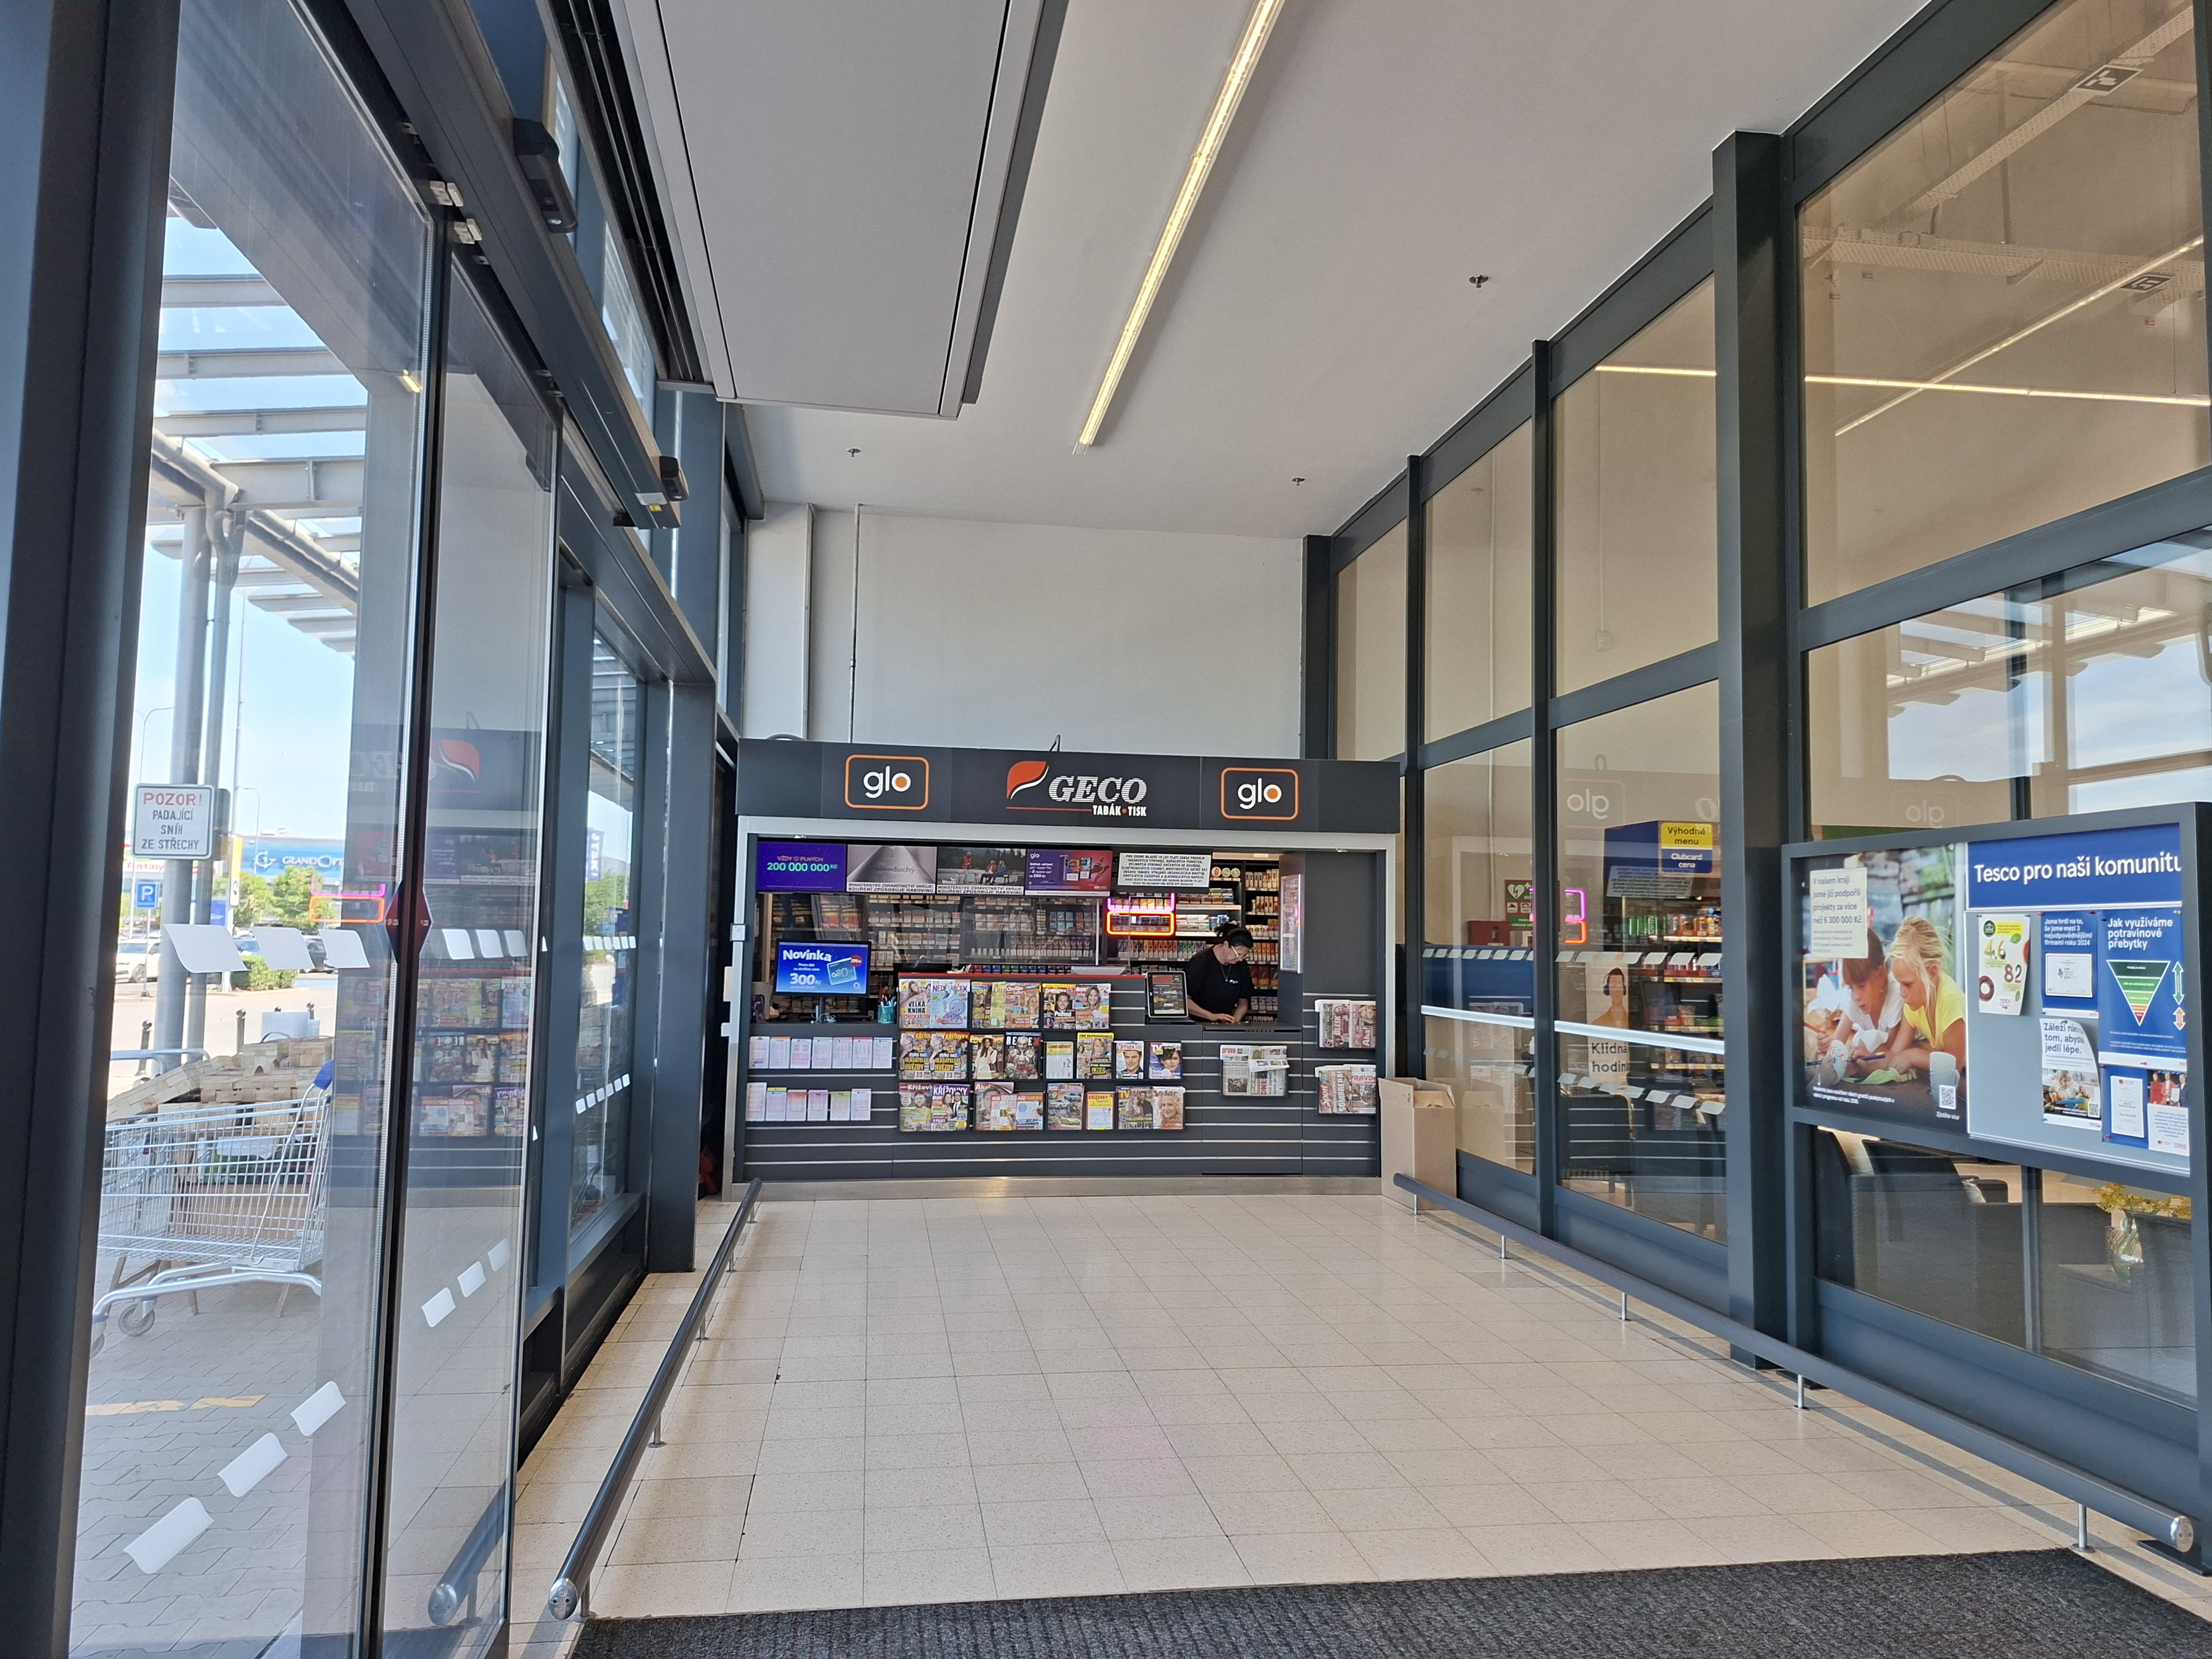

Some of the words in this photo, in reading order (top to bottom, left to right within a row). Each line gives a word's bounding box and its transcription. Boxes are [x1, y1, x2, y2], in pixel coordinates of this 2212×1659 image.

[863, 765, 911, 799] glo
[1048, 775, 1147, 804] GECO
[1238, 778, 1282, 810] glo
[143, 792, 202, 806] POZOR!
[153, 808, 194, 821] PADAJÍCÍ
[1092, 803, 1121, 816] TABÁK
[1128, 806, 1147, 817] TISK
[160, 823, 182, 835] SNÍH
[1667, 826, 1706, 836] Výhodné
[142, 839, 154, 849] ZE
[158, 837, 199, 850] STŘECHY
[767, 862, 786, 871] 200
[789, 863, 808, 872] 000
[811, 863, 830, 872] 000
[1974, 864, 2020, 883] Tesco
[2023, 865, 2053, 885] pro
[2057, 855, 2090, 878] naši
[1837, 876, 1850, 885] kraji
[142, 885, 153, 901] P
[1835, 889, 1861, 899] podpořili
[1813, 904, 1835, 912] projekty
[1854, 915, 1863, 924] Kč
[2107, 918, 2123, 927] Jak
[2125, 917, 2173, 930] využíváme
[2108, 928, 2162, 939] potravinové
[782, 950, 832, 962] Novinka
[790, 973, 816, 985] 300
[1333, 1015, 1342, 1036] BLESK
[2044, 1022, 2066, 1031] Záleží
[1362, 1027, 1371, 1047] Aha!
[2044, 1034, 2062, 1043] tom,
[2064, 1035, 2084, 1045] abyste
[1591, 1042, 1627, 1055] Klidná
[2045, 1043, 2061, 1053] jedli
[2063, 1044, 2081, 1055] lépe.
[933, 1085, 968, 1095] KŘÍŽOVKY
[1119, 1090, 1130, 1098] TV
